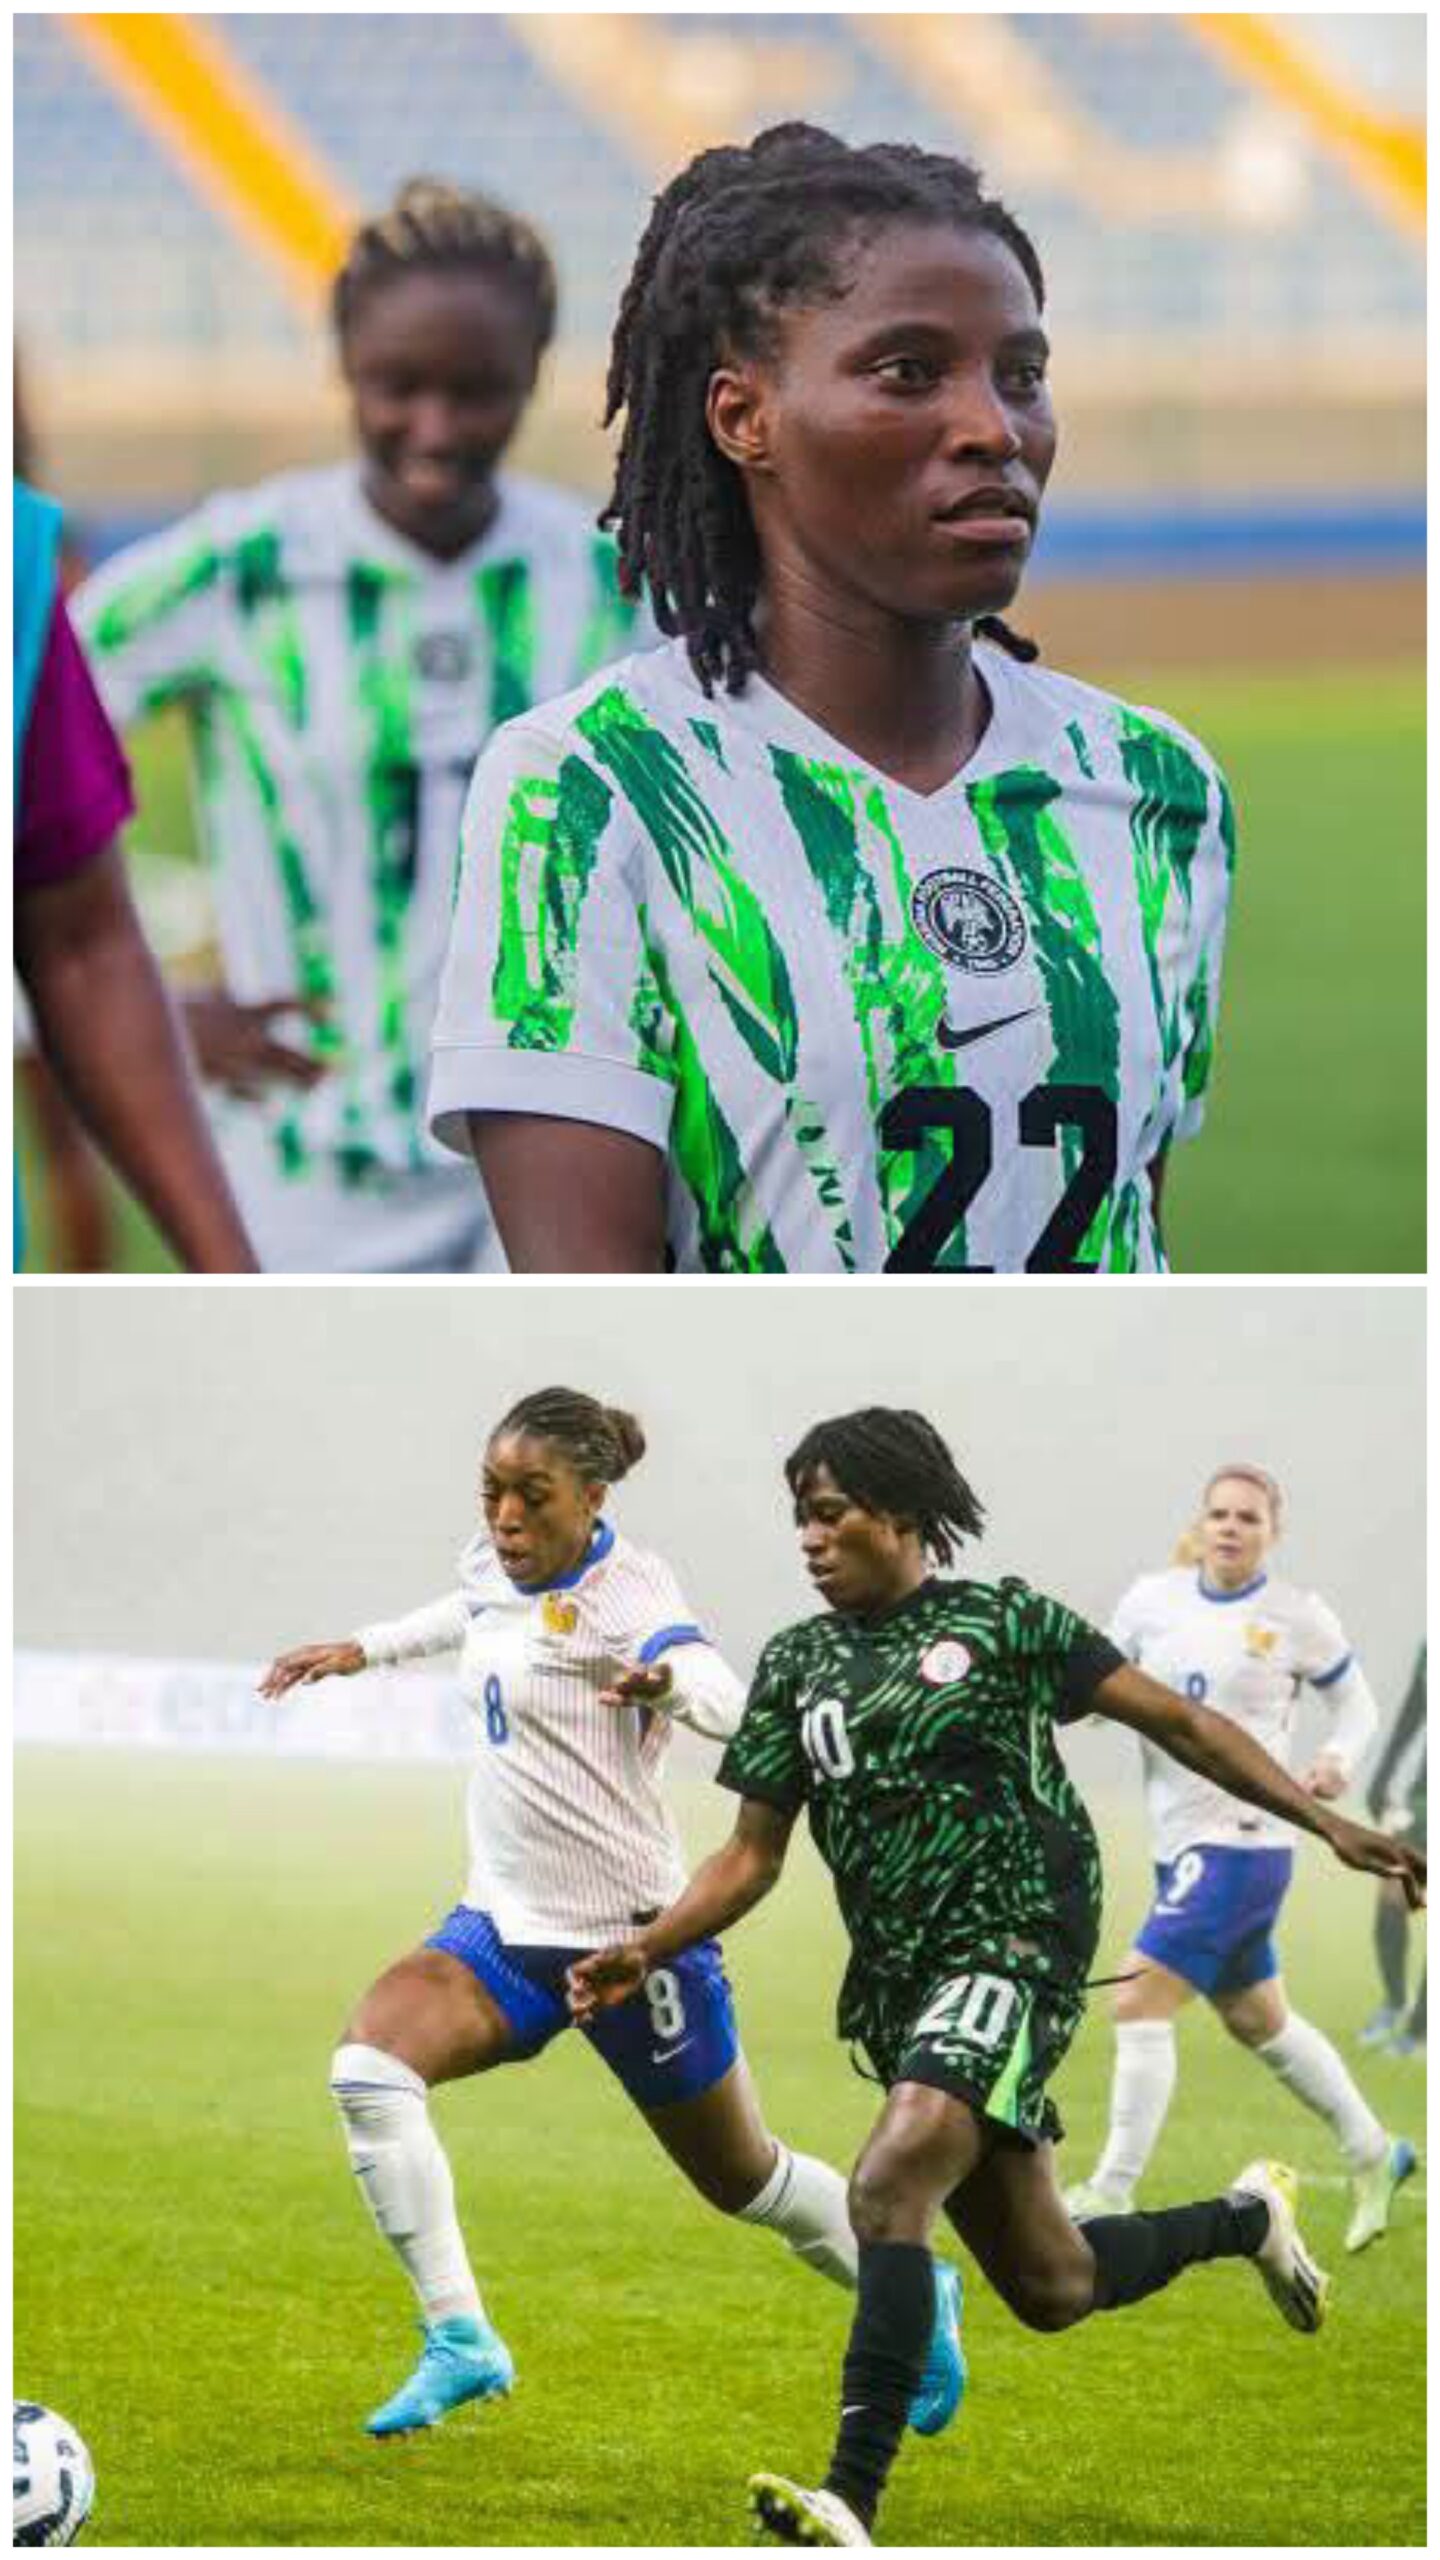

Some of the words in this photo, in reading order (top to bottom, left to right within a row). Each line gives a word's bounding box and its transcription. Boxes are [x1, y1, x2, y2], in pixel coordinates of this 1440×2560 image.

[878, 1086, 1118, 1273] 22
[484, 1672, 508, 1745] 8
[1166, 1851, 1204, 1904] 9
[645, 1968, 686, 2039] 8
[913, 1972, 1016, 2050] 20
